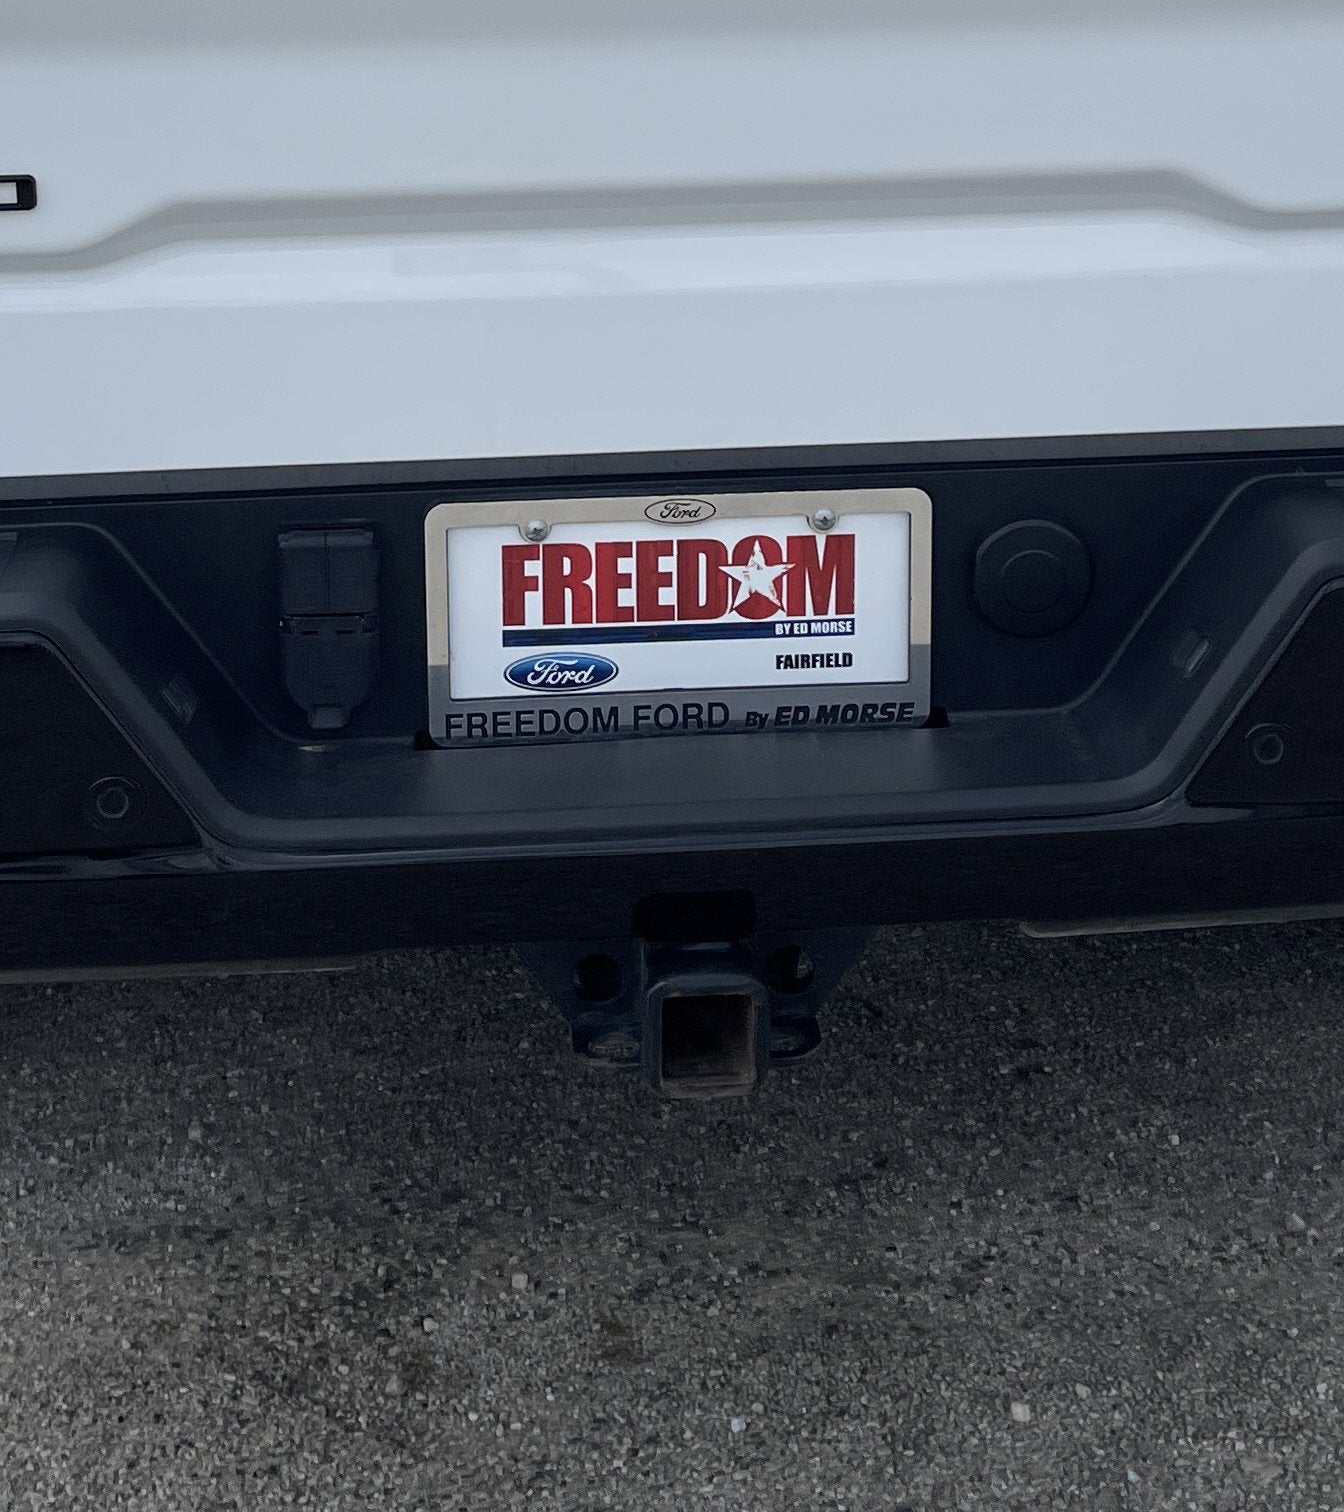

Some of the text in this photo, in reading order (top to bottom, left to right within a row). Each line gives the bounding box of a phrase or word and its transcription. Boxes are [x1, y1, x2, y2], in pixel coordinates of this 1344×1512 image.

[659, 502, 703, 520] Ford
[502, 534, 856, 626] FREEDOM
[775, 620, 853, 636] BY ED MORSE
[527, 657, 595, 685] Ford
[775, 652, 853, 670] FAIRFIELD
[445, 702, 915, 739] FREEDOM FORD By ED MORSE
